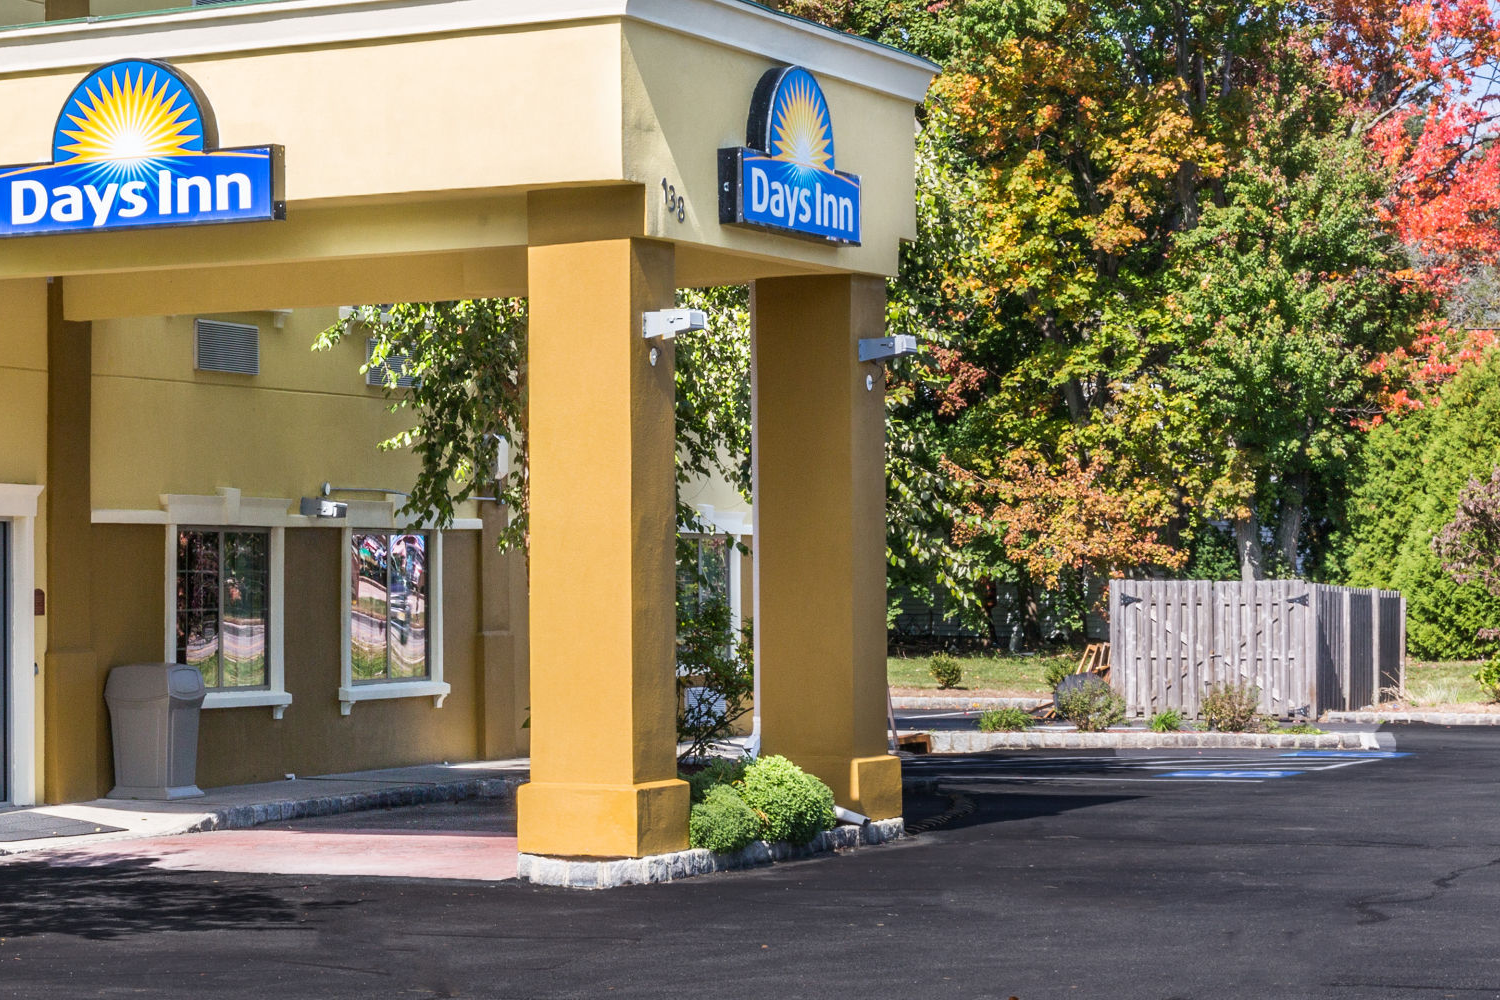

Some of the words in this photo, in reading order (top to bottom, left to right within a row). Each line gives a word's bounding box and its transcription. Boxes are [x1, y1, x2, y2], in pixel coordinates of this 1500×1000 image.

[10, 178, 148, 227] Days
[158, 169, 252, 215] Inn
[661, 176, 685, 224] 138
[751, 166, 812, 227] Days
[815, 182, 854, 233] Inn
